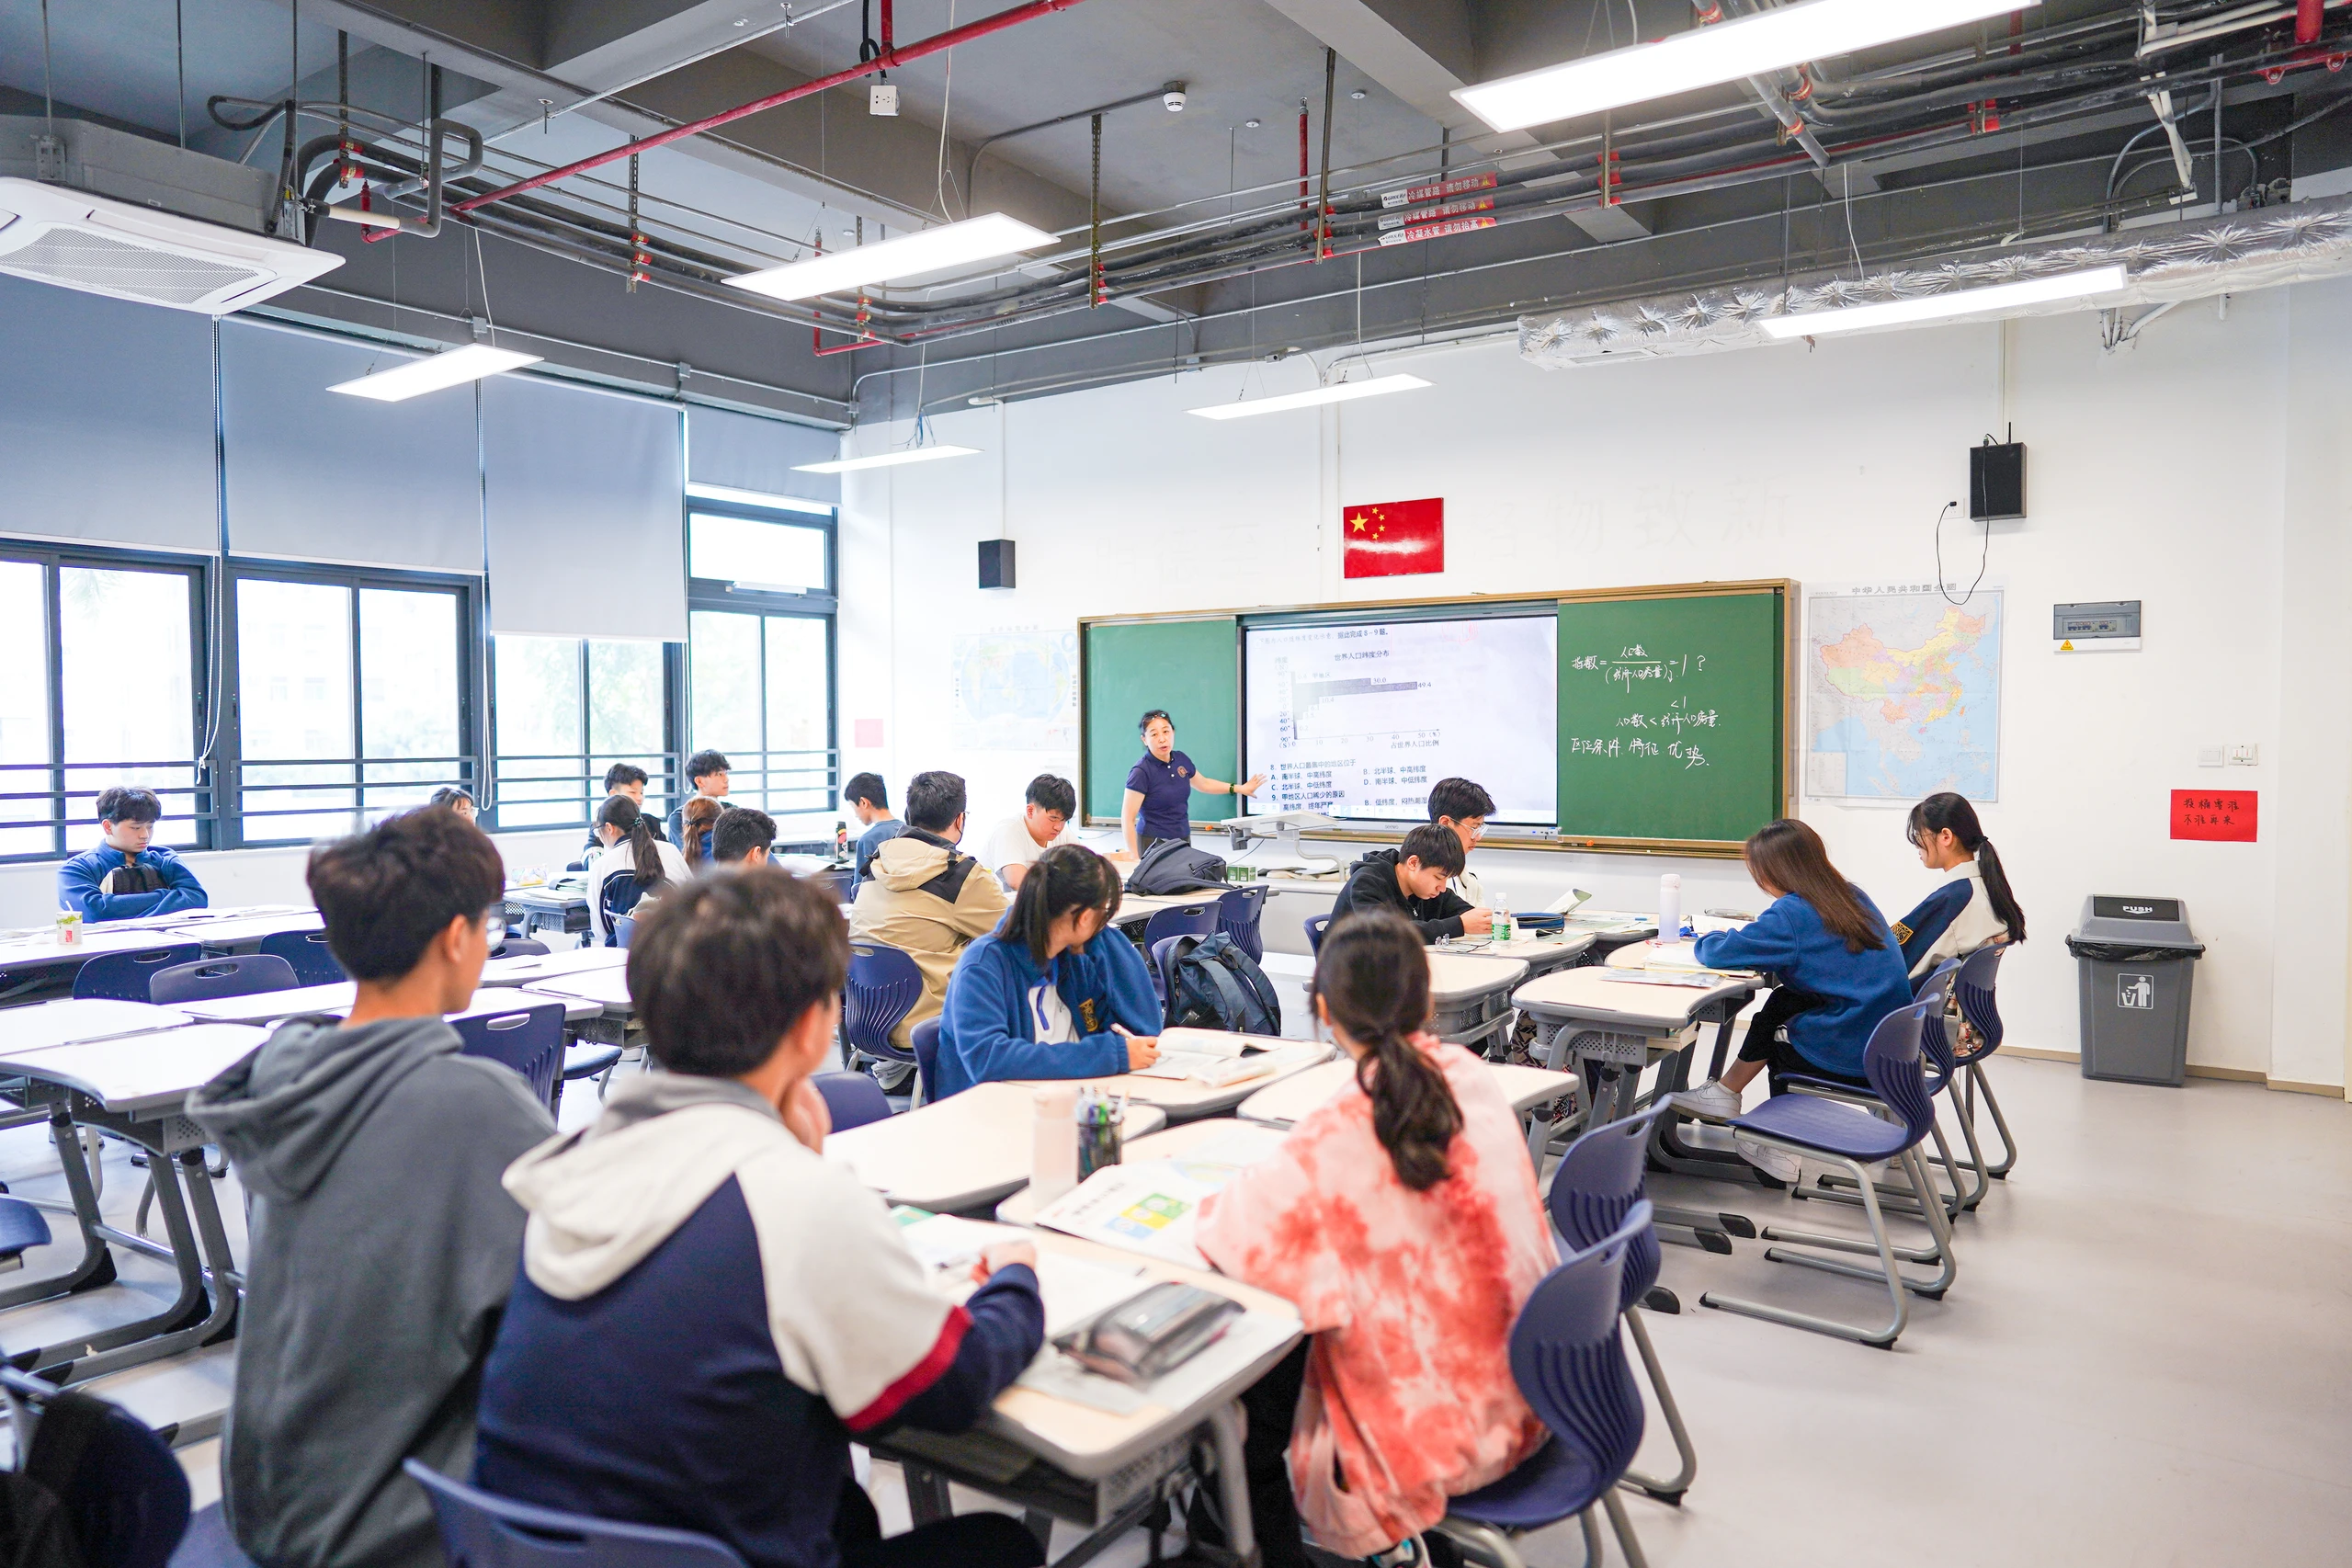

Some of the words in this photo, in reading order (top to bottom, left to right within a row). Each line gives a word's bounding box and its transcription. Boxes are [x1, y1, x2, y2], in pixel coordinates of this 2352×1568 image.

[1446, 177, 1479, 193] 请勿移动
[1442, 201, 1476, 215] 请勿移动
[1407, 226, 1440, 240] 冷凝水管
[1444, 219, 1479, 233] 请勿抬高
[1851, 583, 1957, 595] 中华人民共和国全图
[1335, 650, 1390, 662] 世界人口纬度分布
[1391, 740, 1440, 749] 占世界人口比例
[1280, 758, 1356, 770] 世界人口最集中的地区位于
[1374, 765, 1426, 775] 北半球、中高纬度
[1281, 770, 1332, 780] 南半球、中高纬度
[1375, 776, 1427, 785] 南半球、中低纬度
[1281, 781, 1332, 790] 北半球、中低纬度
[1282, 790, 1346, 801] 甲地区人口稀少的原因
[2184, 814, 2234, 826] 不准再来
